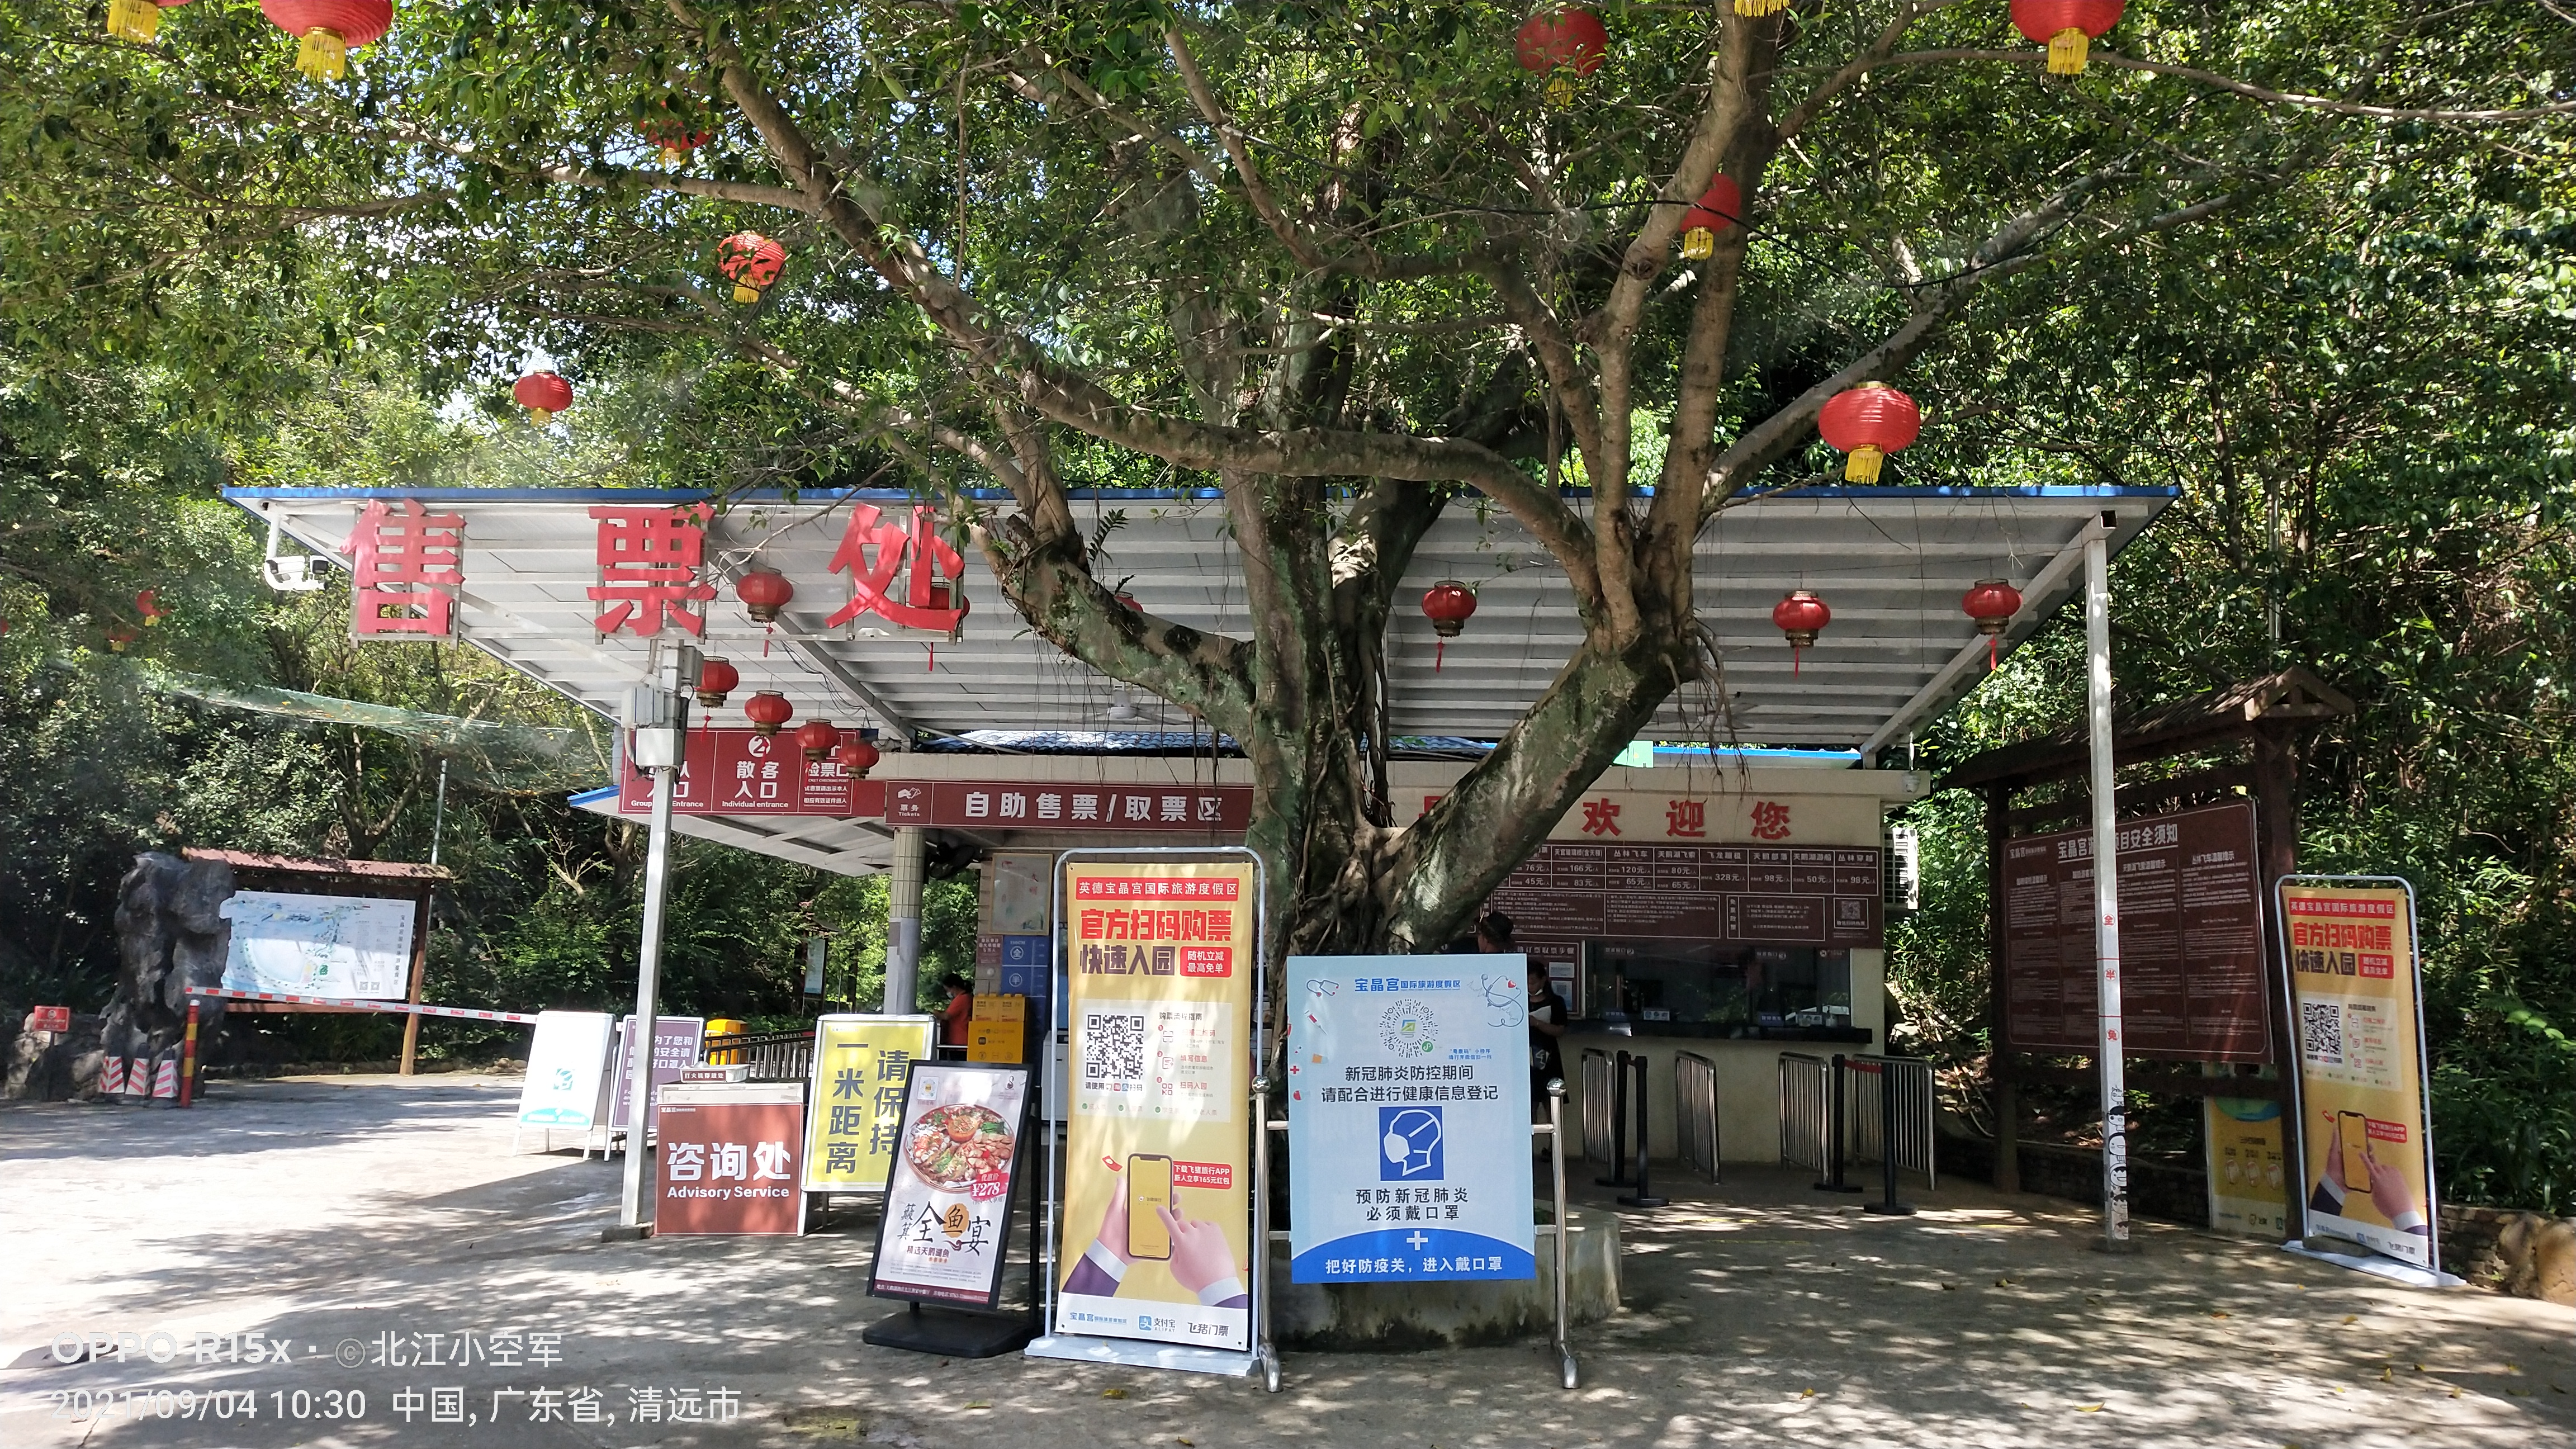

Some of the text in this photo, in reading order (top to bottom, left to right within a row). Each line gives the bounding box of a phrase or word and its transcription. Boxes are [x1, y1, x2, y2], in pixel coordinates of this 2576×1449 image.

[339, 498, 964, 637] 售票处
[736, 761, 779, 779] 散客
[735, 781, 777, 799] 入口
[965, 791, 1223, 822] 自助售票/取票区
[1581, 797, 1791, 840] 欢迎您
[2058, 823, 2179, 859] 宝晶宫目安全须知
[1614, 849, 1648, 858] 丛林飞车
[1570, 864, 1599, 873] 166元/人
[1621, 865, 1651, 874] 120元/人
[1671, 866, 1697, 875] 80元/人
[1715, 873, 1746, 882] 328元/人
[1764, 874, 1789, 883] 98元/人
[1807, 875, 1832, 883] 50元/人
[1079, 882, 1237, 896] 英德宝晶宫国际旅游度假区
[2290, 901, 2394, 914] 英德宝晶宫国际旅游度假区
[1081, 908, 1232, 941] 官方扫码购票
[2104, 915, 2113, 925] 全
[2293, 922, 2392, 951] 官方扫码购票
[1079, 944, 1176, 976] 快速入园
[1187, 951, 1224, 962] 随机立减
[2295, 949, 2356, 976] 快速入园
[1187, 962, 1224, 973] 最高免单
[2106, 969, 2115, 979] 半
[1355, 978, 1461, 992] 宝晶宫国际旅游度假区
[1159, 1012, 1202, 1021] 购票流程指南
[1345, 1064, 1474, 1081] 新冠肺炎防控期间
[1180, 1082, 1208, 1090] 扫码入园
[1321, 1085, 1499, 1103] 请配合进行健康信息登记
[826, 1043, 869, 1174] 一米距离
[869, 1050, 909, 1156] 请保持
[667, 1142, 790, 1181] 咨询处
[1174, 1164, 1230, 1175] 下载飞猪旅行APP
[1174, 1174, 1230, 1185] 新人立享165元红包
[667, 1186, 789, 1200] Advisory Service
[972, 1182, 1001, 1196] ¥278
[1356, 1187, 1469, 1204] 预防新冠肺炎
[1366, 1205, 1460, 1221] 必须戴口罩
[912, 1201, 991, 1256] 全鱼宴
[1325, 1256, 1503, 1274] 把好防疫关，进入戴口罩
[1154, 1318, 1176, 1328] 支付宝
[1187, 1322, 1230, 1337] 飞猪门票
